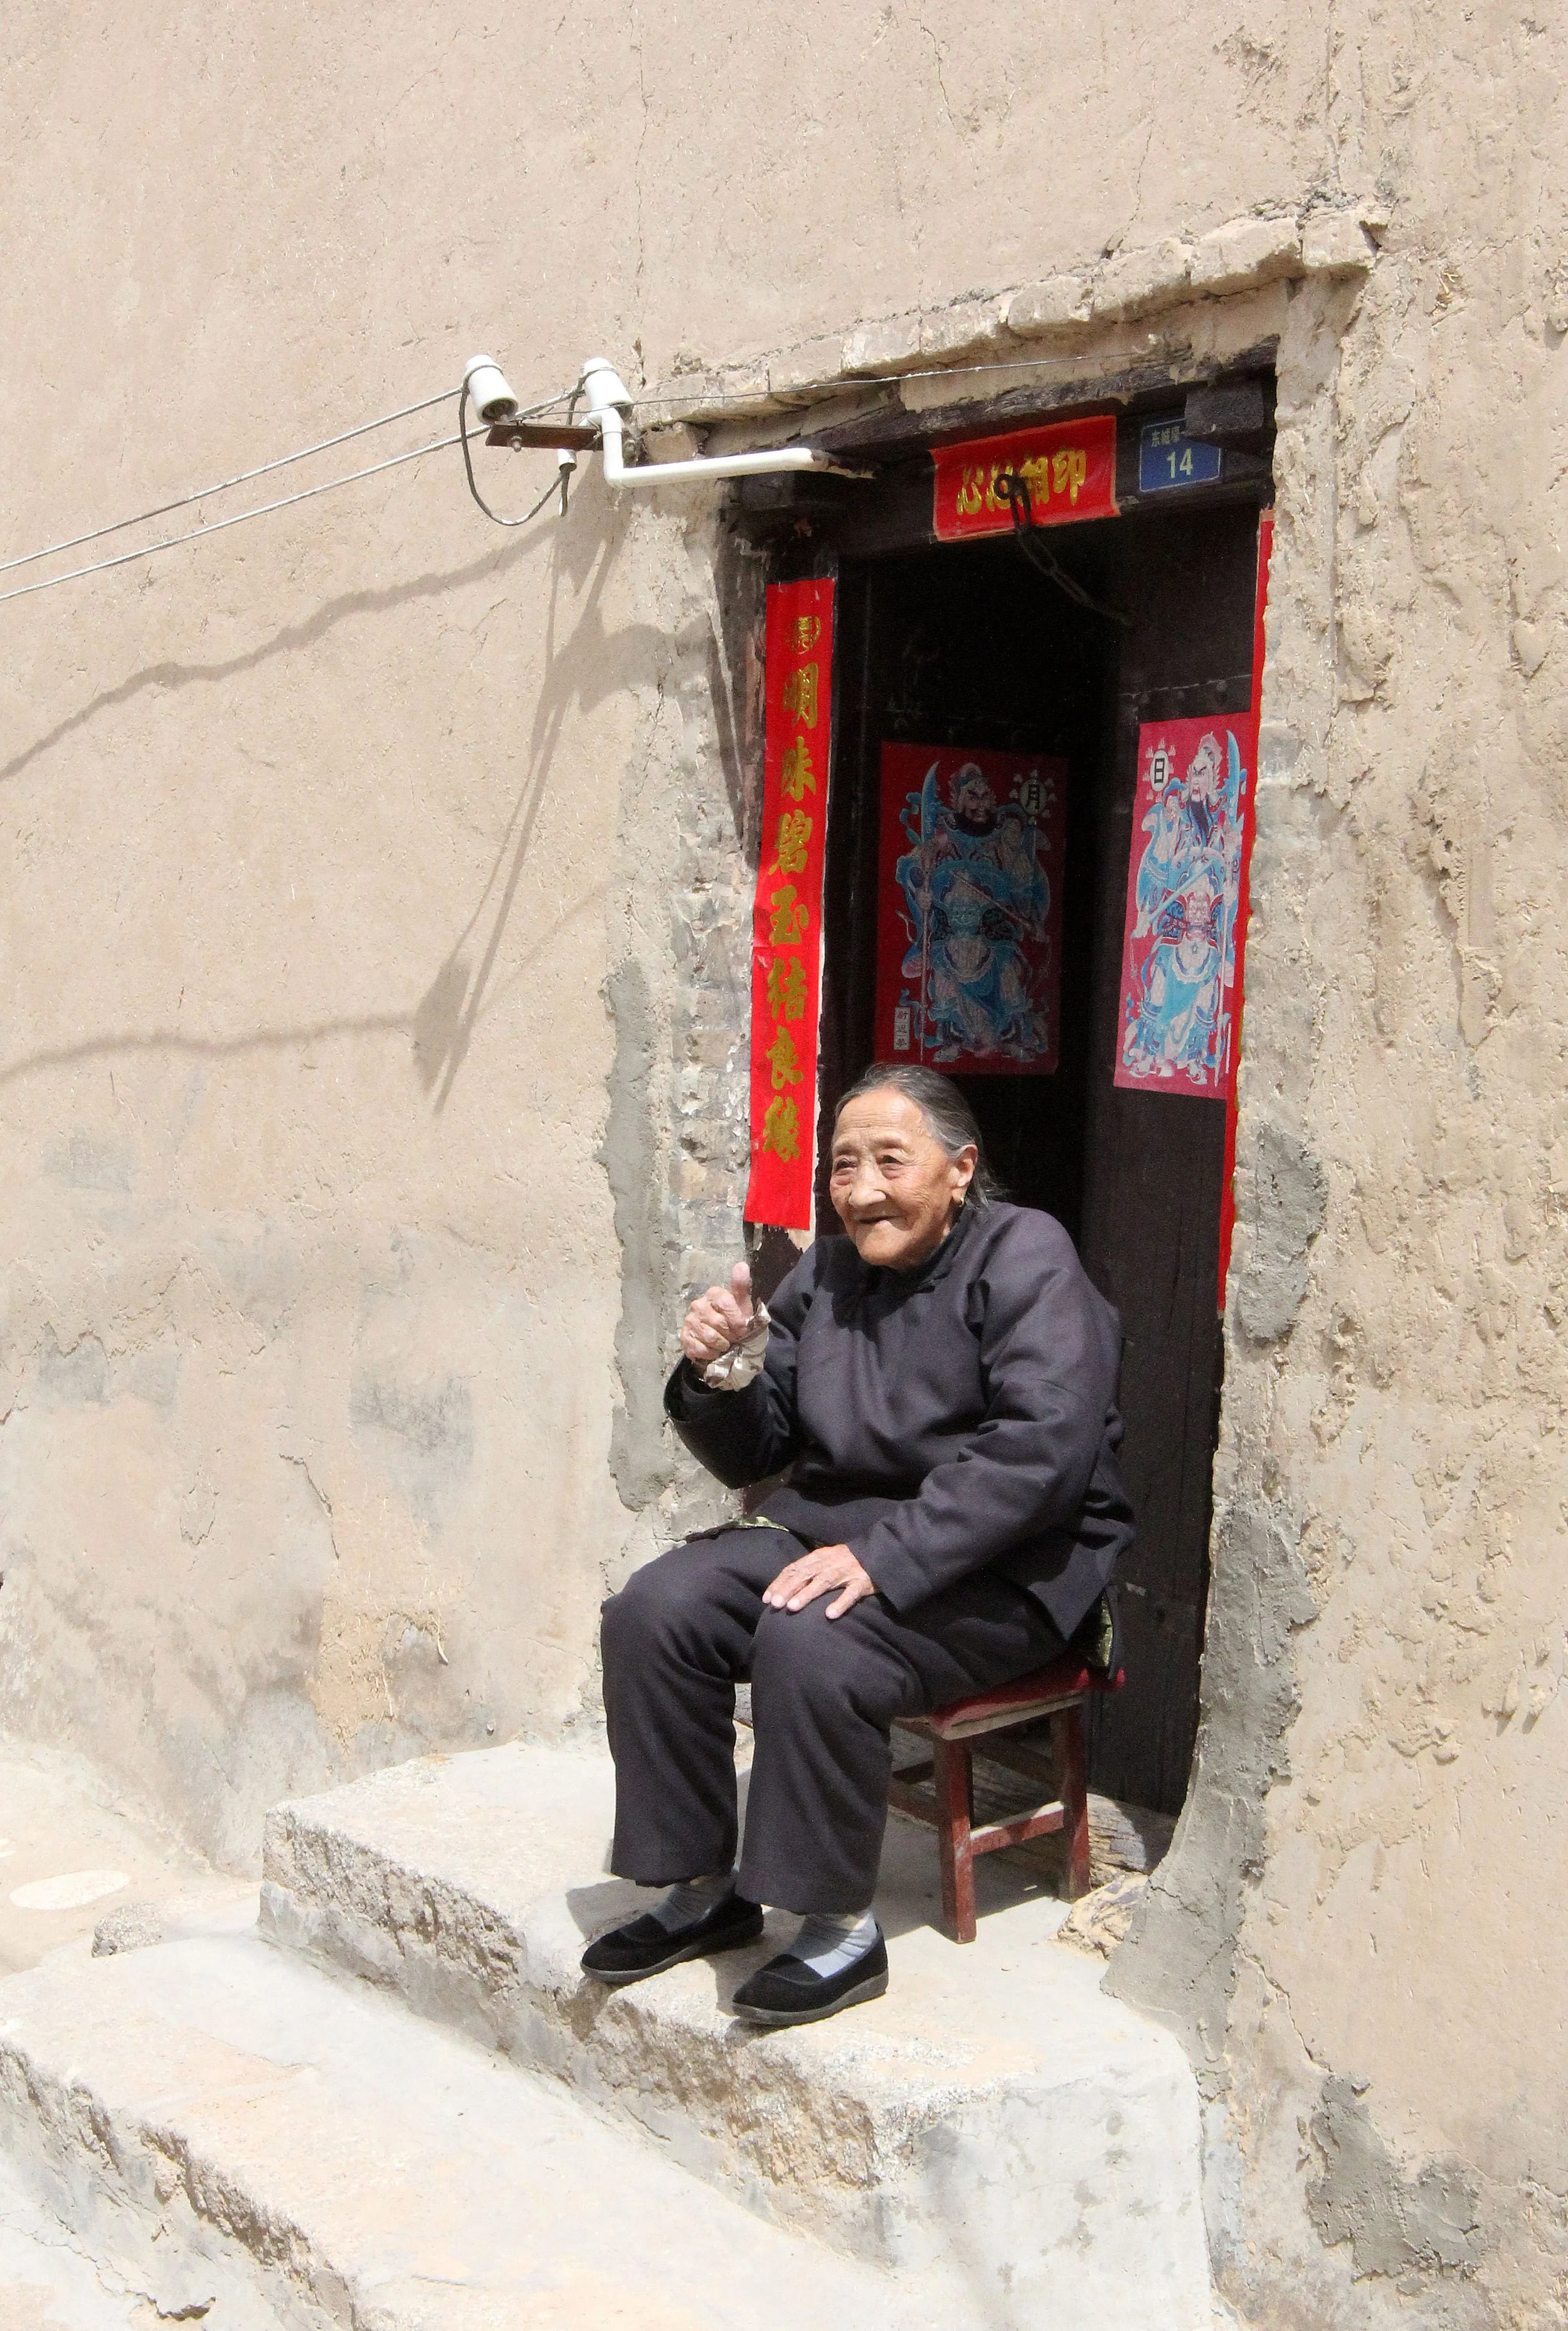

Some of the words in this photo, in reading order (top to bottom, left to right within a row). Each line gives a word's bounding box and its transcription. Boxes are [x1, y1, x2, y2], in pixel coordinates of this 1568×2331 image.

[1166, 448, 1194, 479] 14
[956, 449, 1086, 516] 心心相印
[1154, 758, 1165, 783] 日
[1028, 785, 1040, 809] 月
